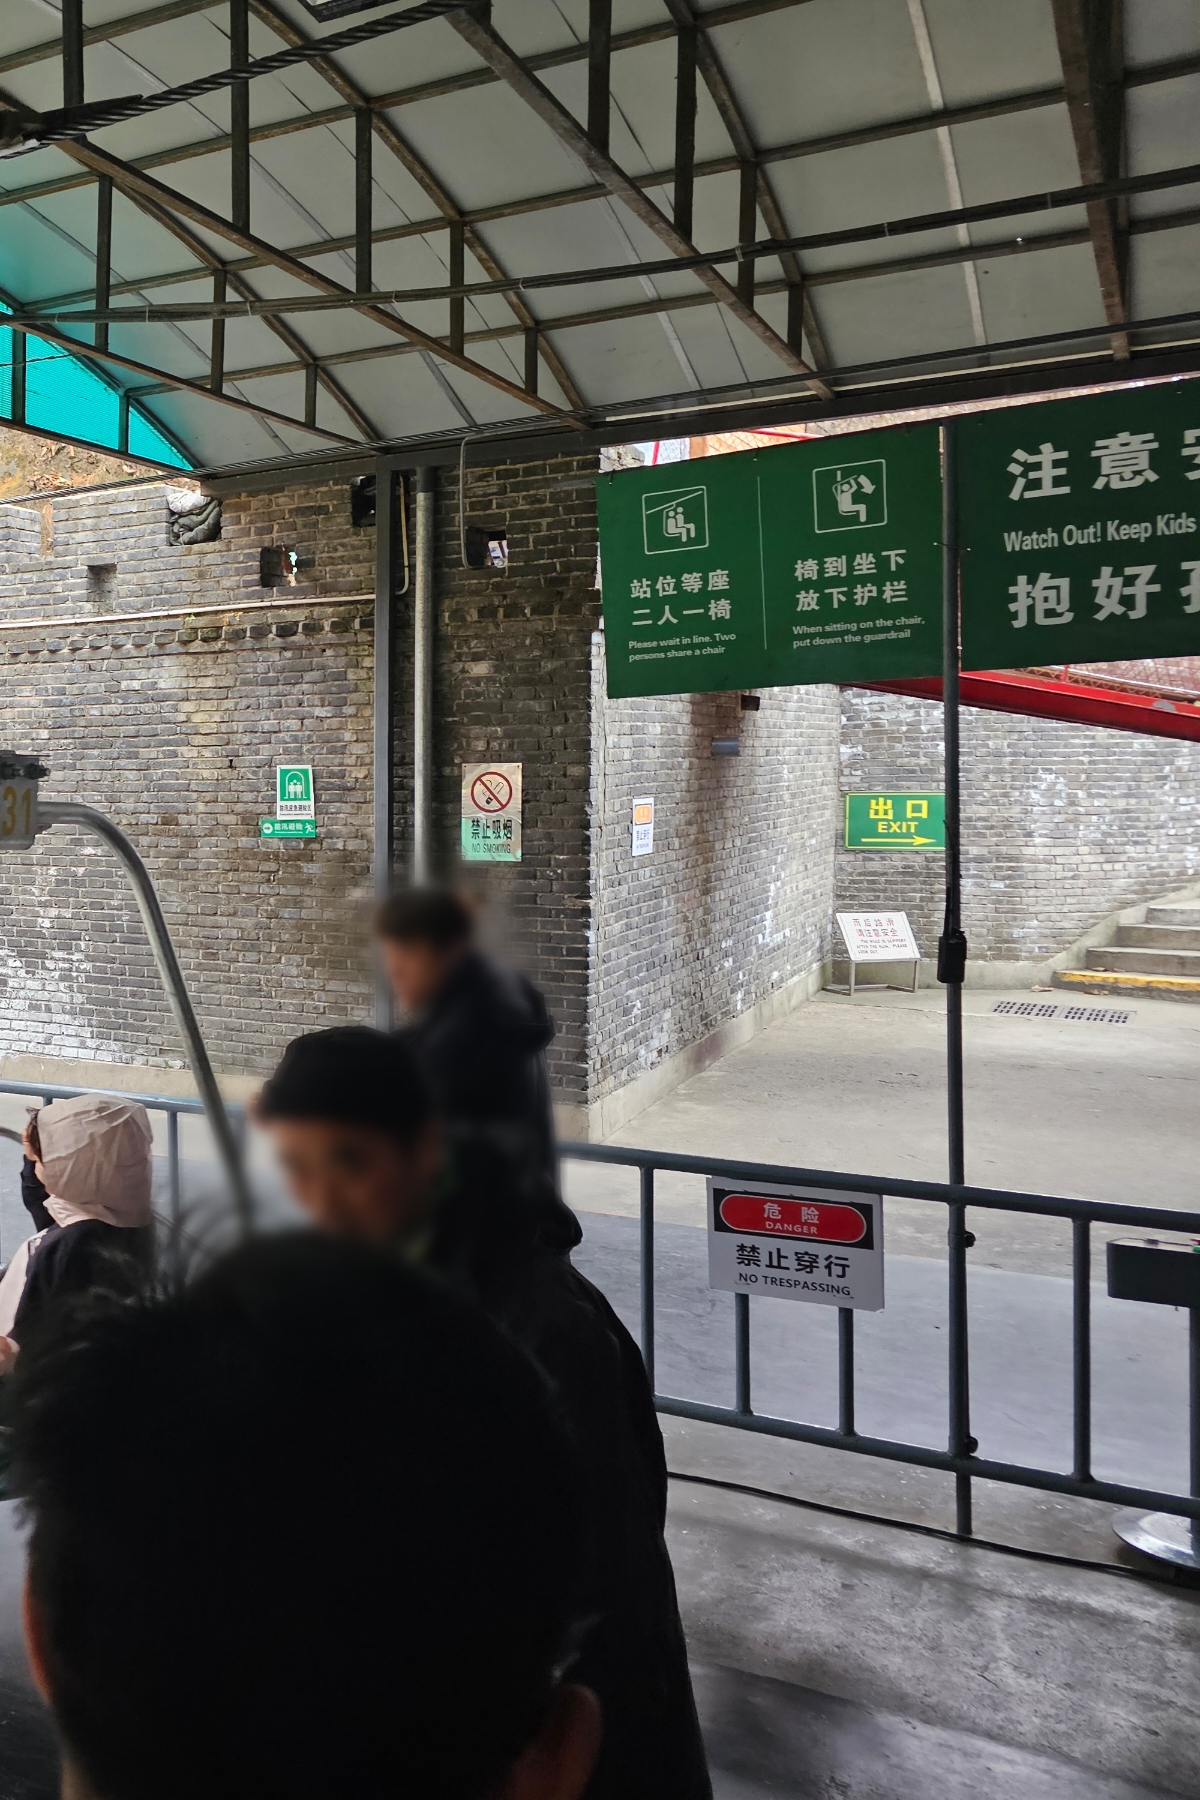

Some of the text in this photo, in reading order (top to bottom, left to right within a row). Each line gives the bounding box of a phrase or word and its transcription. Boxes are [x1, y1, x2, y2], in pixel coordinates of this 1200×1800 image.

[1004, 511, 1197, 552] Watch Out! Keep Kids
[794, 549, 907, 582] 椅到坐下
[629, 568, 730, 599] 站位等座
[795, 580, 908, 612] 放下护栏
[632, 598, 732, 626] 二人一椅
[792, 615, 926, 635] When sitting on the chair,
[628, 632, 737, 650] Please wait in line. Two
[792, 629, 911, 650] put down the guardrail
[628, 645, 726, 663] persons share a chair
[2, 786, 32, 837] 31
[869, 797, 928, 819] 出口
[470, 818, 513, 841] 禁止吸烟
[877, 821, 919, 834] EXIT
[471, 843, 511, 854] NO SMOKING
[763, 1202, 820, 1224] 危险
[765, 1221, 818, 1235] DANGER
[736, 1243, 850, 1278] 禁止穿行
[738, 1272, 850, 1295] NO TRESPASSING
